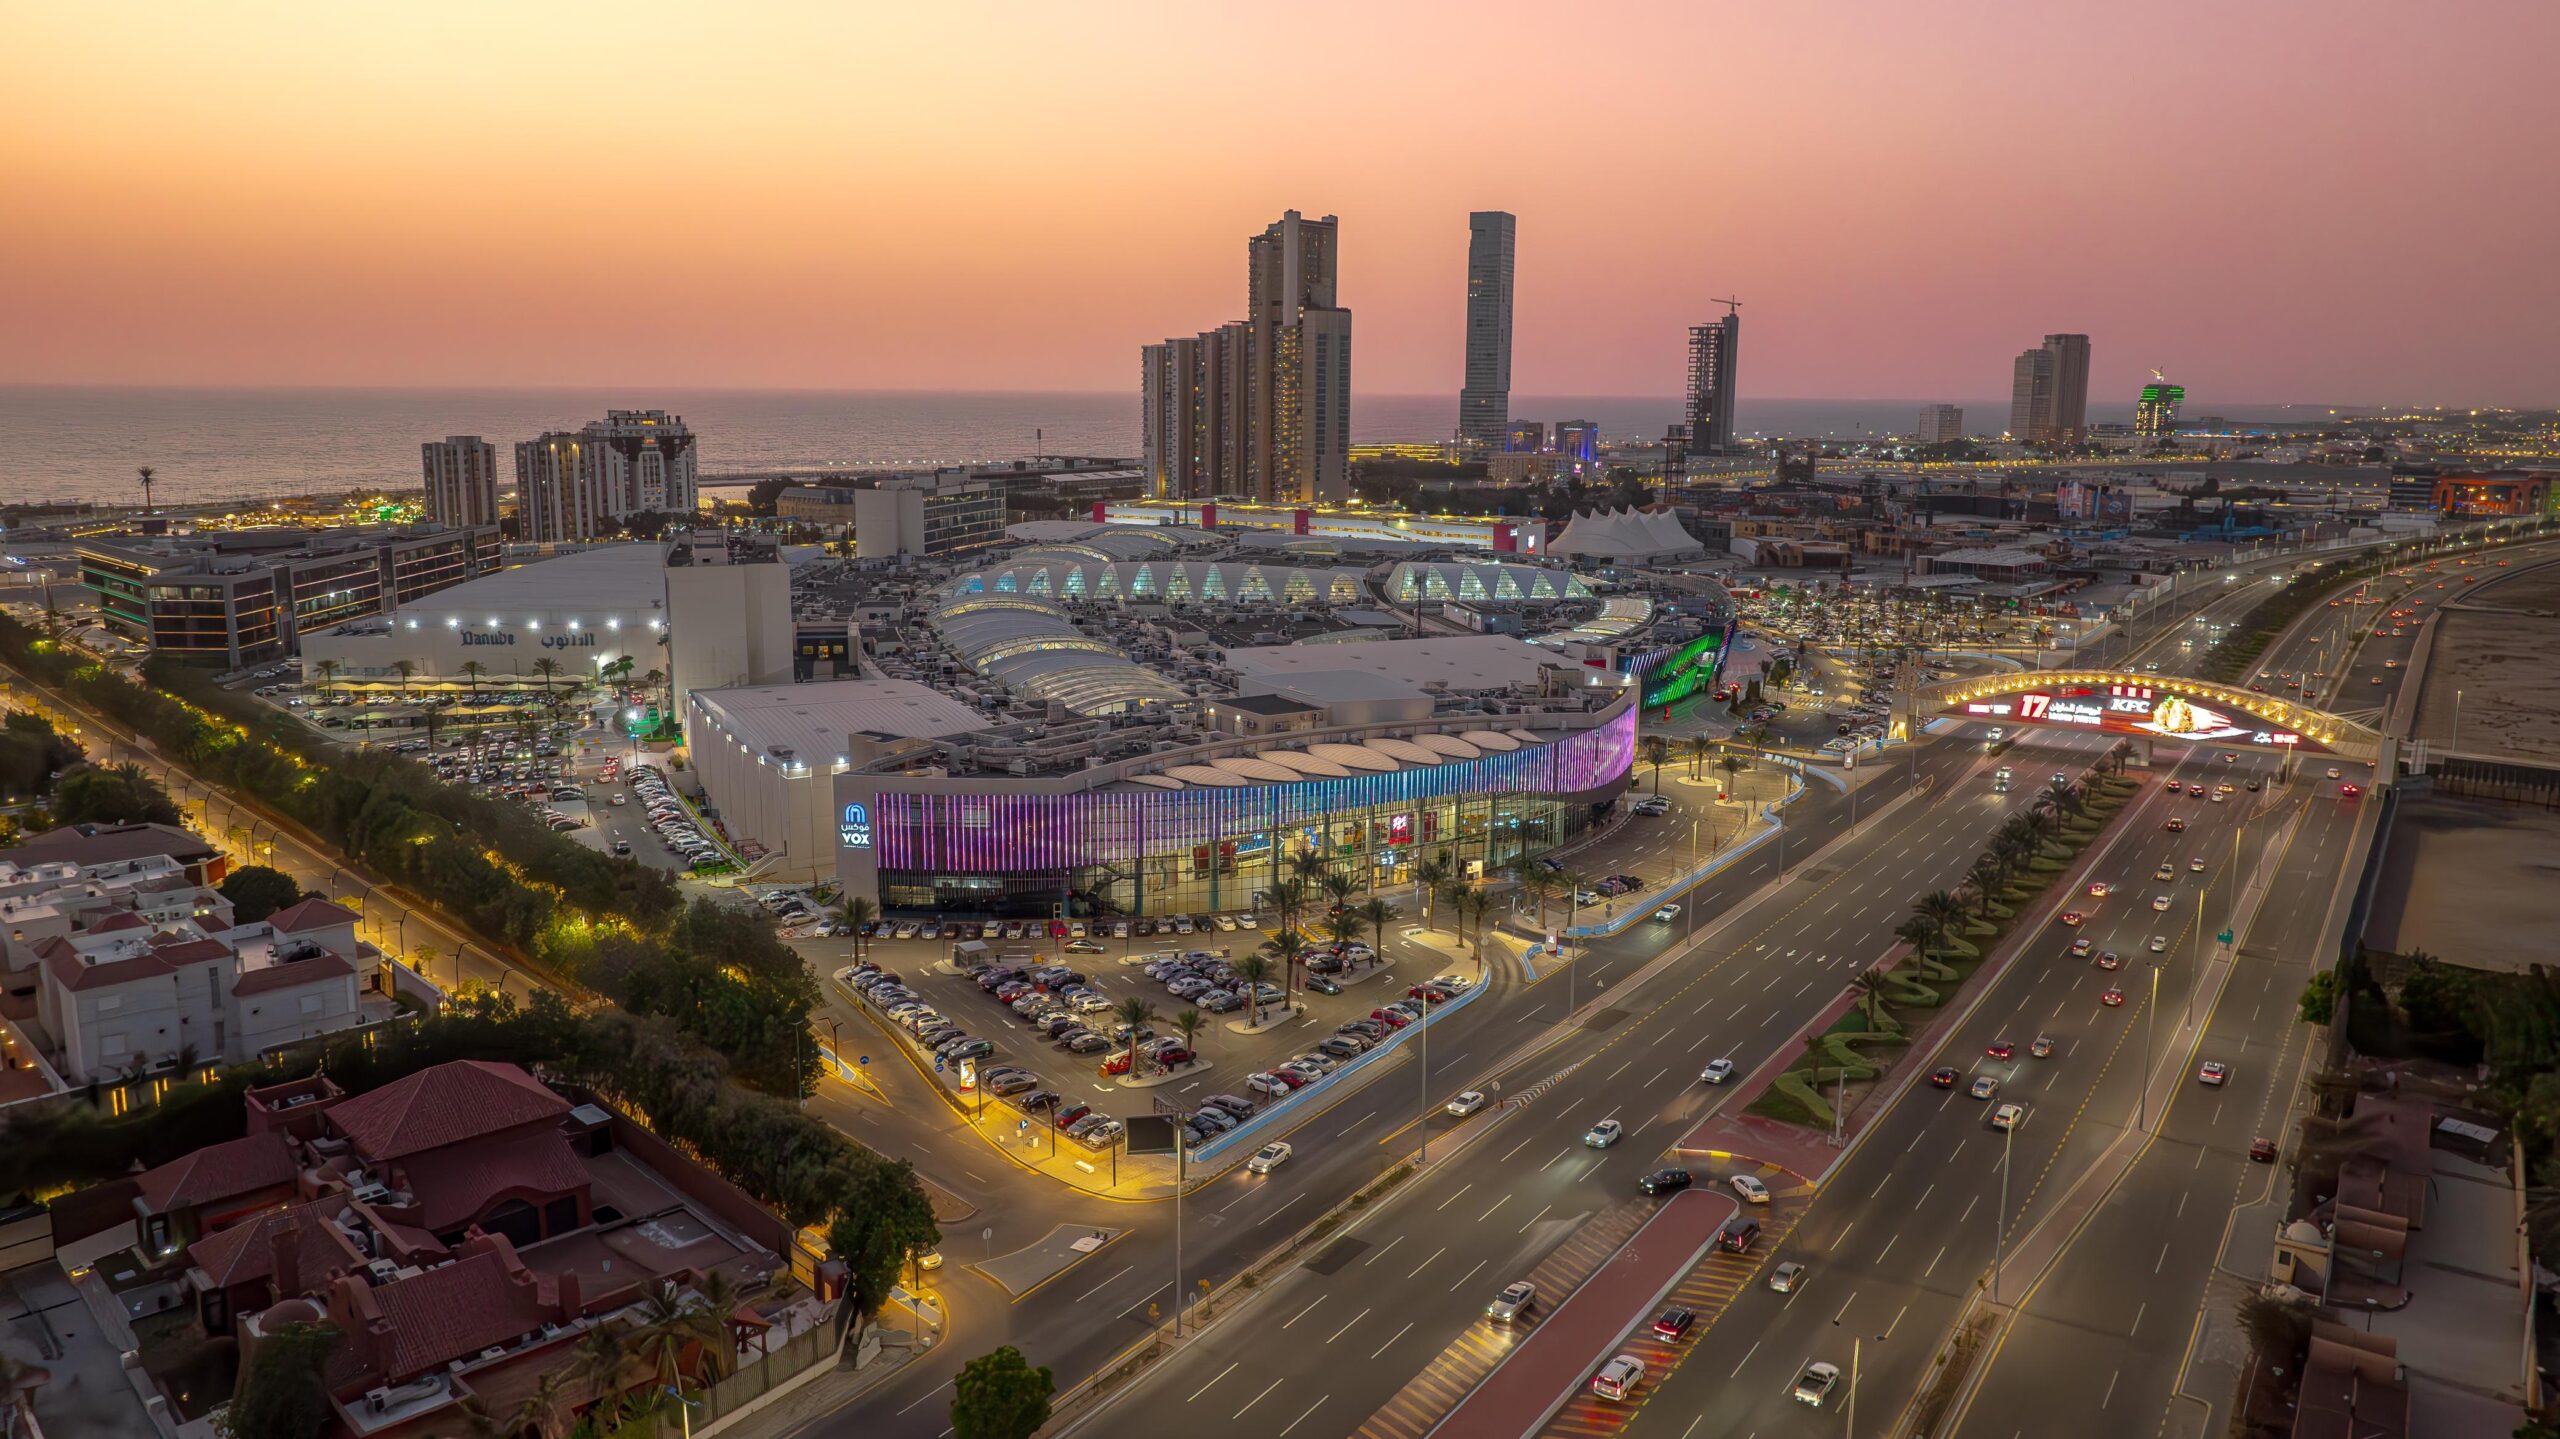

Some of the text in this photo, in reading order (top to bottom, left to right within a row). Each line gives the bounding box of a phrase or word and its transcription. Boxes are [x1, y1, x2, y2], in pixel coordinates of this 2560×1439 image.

[461, 630, 515, 646] Danube
[541, 632, 595, 649] الدانوب
[2021, 695, 2050, 718] 17
[2111, 698, 2150, 713] KFC
[842, 833, 870, 845] VOX
